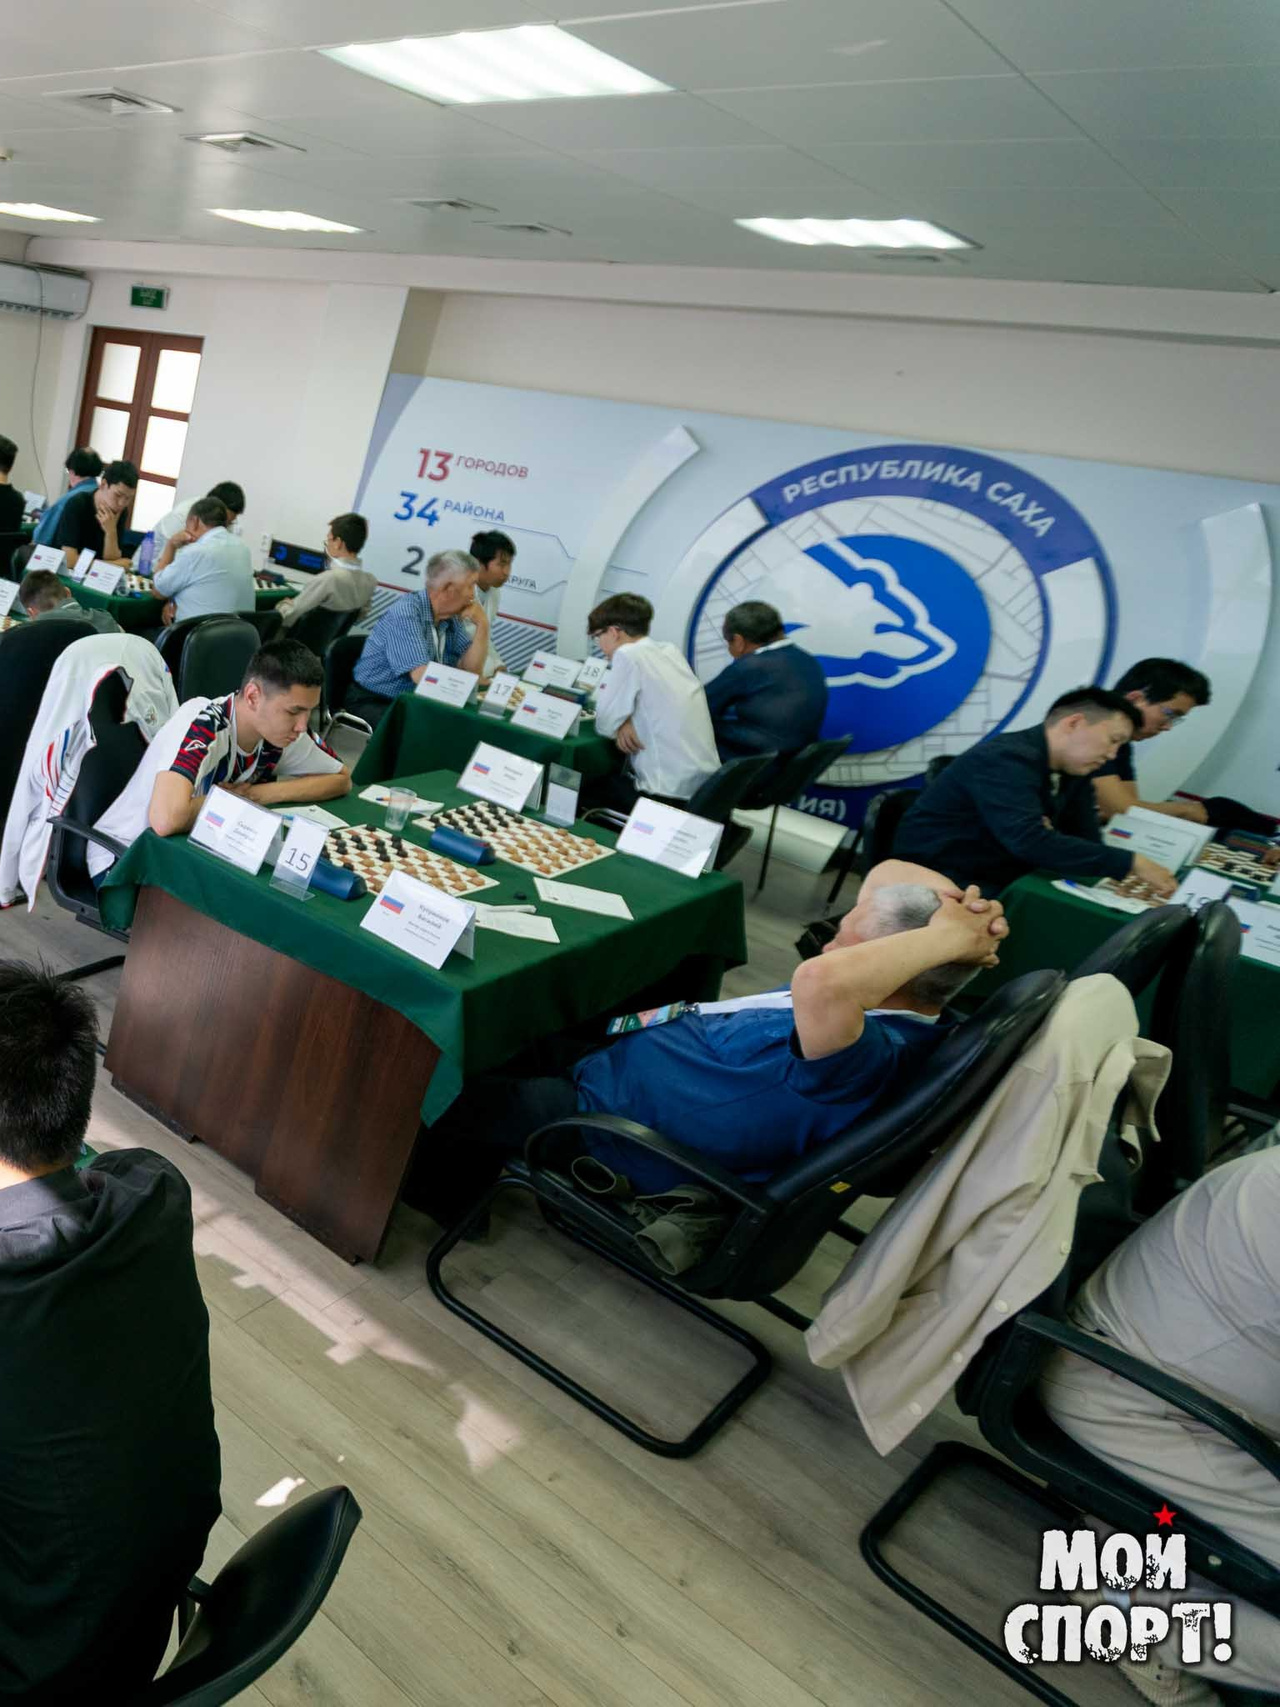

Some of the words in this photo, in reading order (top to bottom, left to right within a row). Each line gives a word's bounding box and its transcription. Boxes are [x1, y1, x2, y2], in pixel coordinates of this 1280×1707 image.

[417, 447, 454, 482] 13
[456, 455, 529, 479] ГОРОДОВ
[393, 490, 440, 527] 34
[443, 499, 505, 522] РАЙОНА
[782, 459, 982, 503] РЕСПУБЛИКА
[986, 481, 1056, 538] САХА
[584, 665, 601, 677] 18
[493, 683, 511, 696] 17
[284, 847, 312, 872] 15
